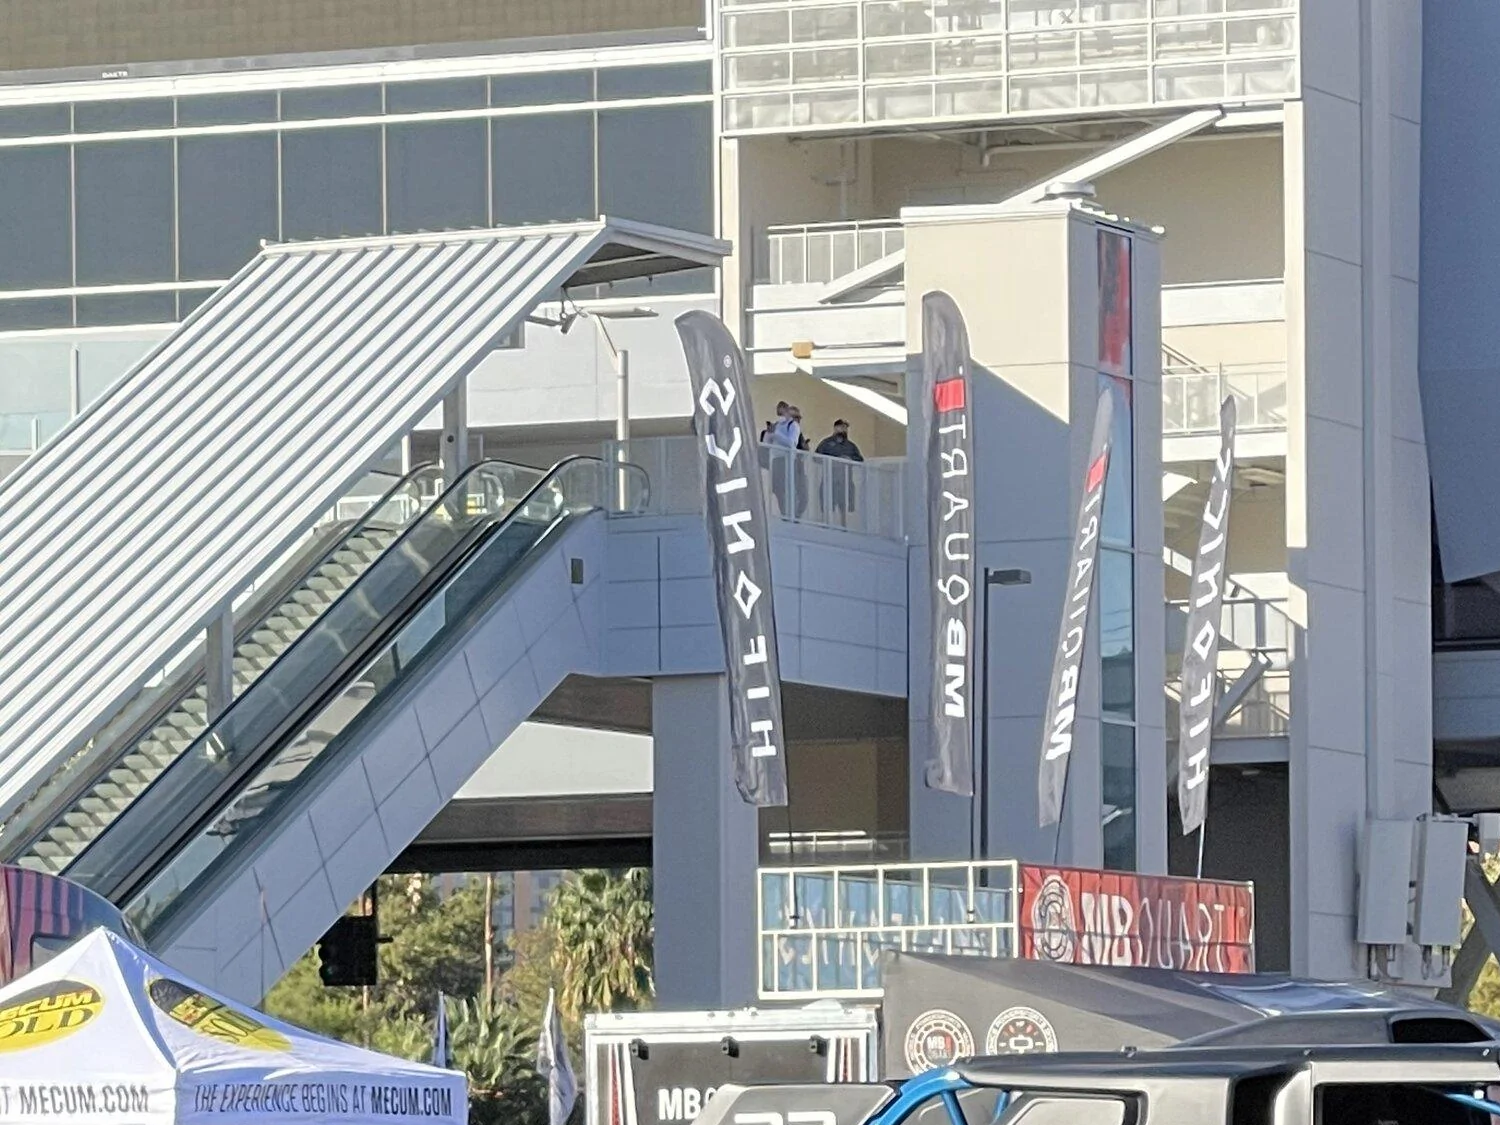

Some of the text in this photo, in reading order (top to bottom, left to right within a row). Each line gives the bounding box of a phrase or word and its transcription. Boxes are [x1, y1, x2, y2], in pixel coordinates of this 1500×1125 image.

[0, 1007, 96, 1039] OLD
[19, 1084, 149, 1115] MECUM.COM
[194, 1083, 453, 1117] THE EXPERIENCE BEGINS AT MECUM.COM
